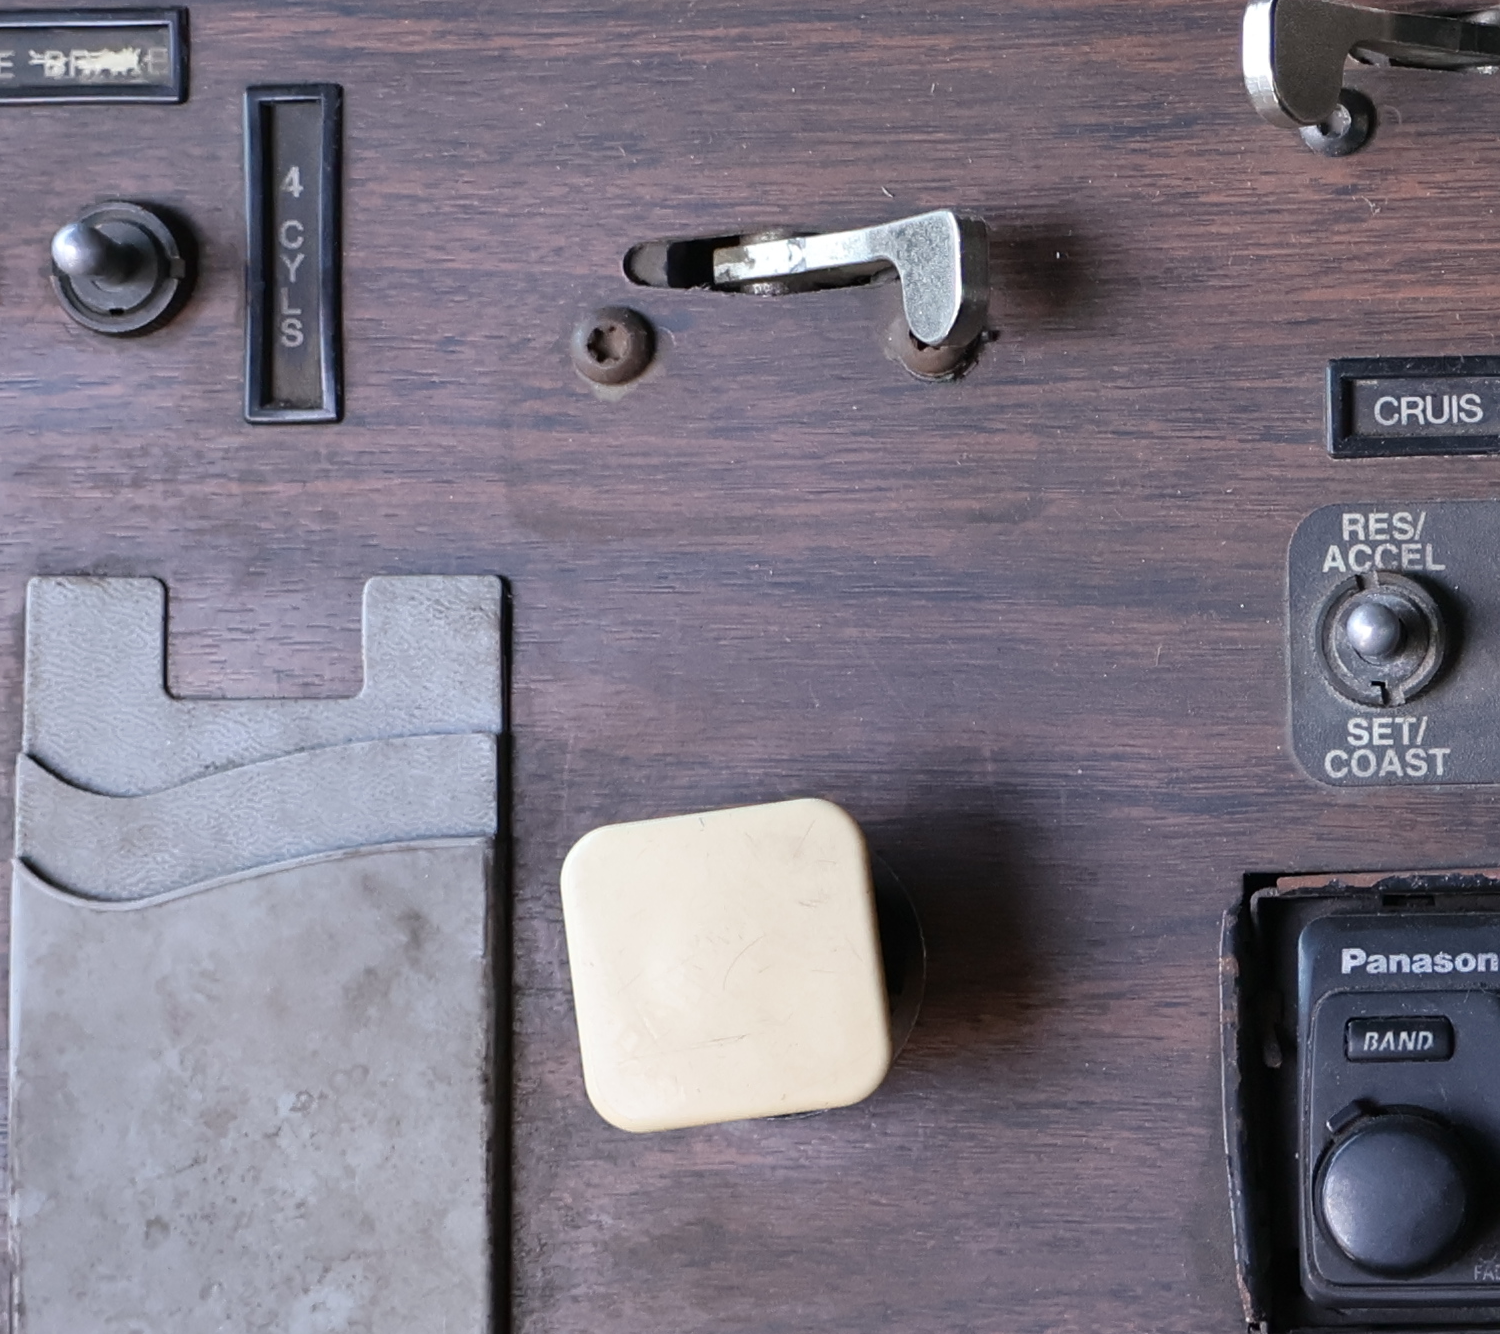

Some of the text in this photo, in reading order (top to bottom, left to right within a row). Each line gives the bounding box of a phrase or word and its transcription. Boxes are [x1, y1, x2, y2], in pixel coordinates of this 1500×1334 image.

[279, 167, 304, 347] 4 CYLS
[1373, 394, 1483, 426] CRUIS
[1342, 512, 1426, 541] RES/
[1322, 544, 1446, 573] ACCEL
[1347, 716, 1428, 746] SET/
[1325, 748, 1449, 778] COAST
[1363, 1031, 1433, 1051] BAND
